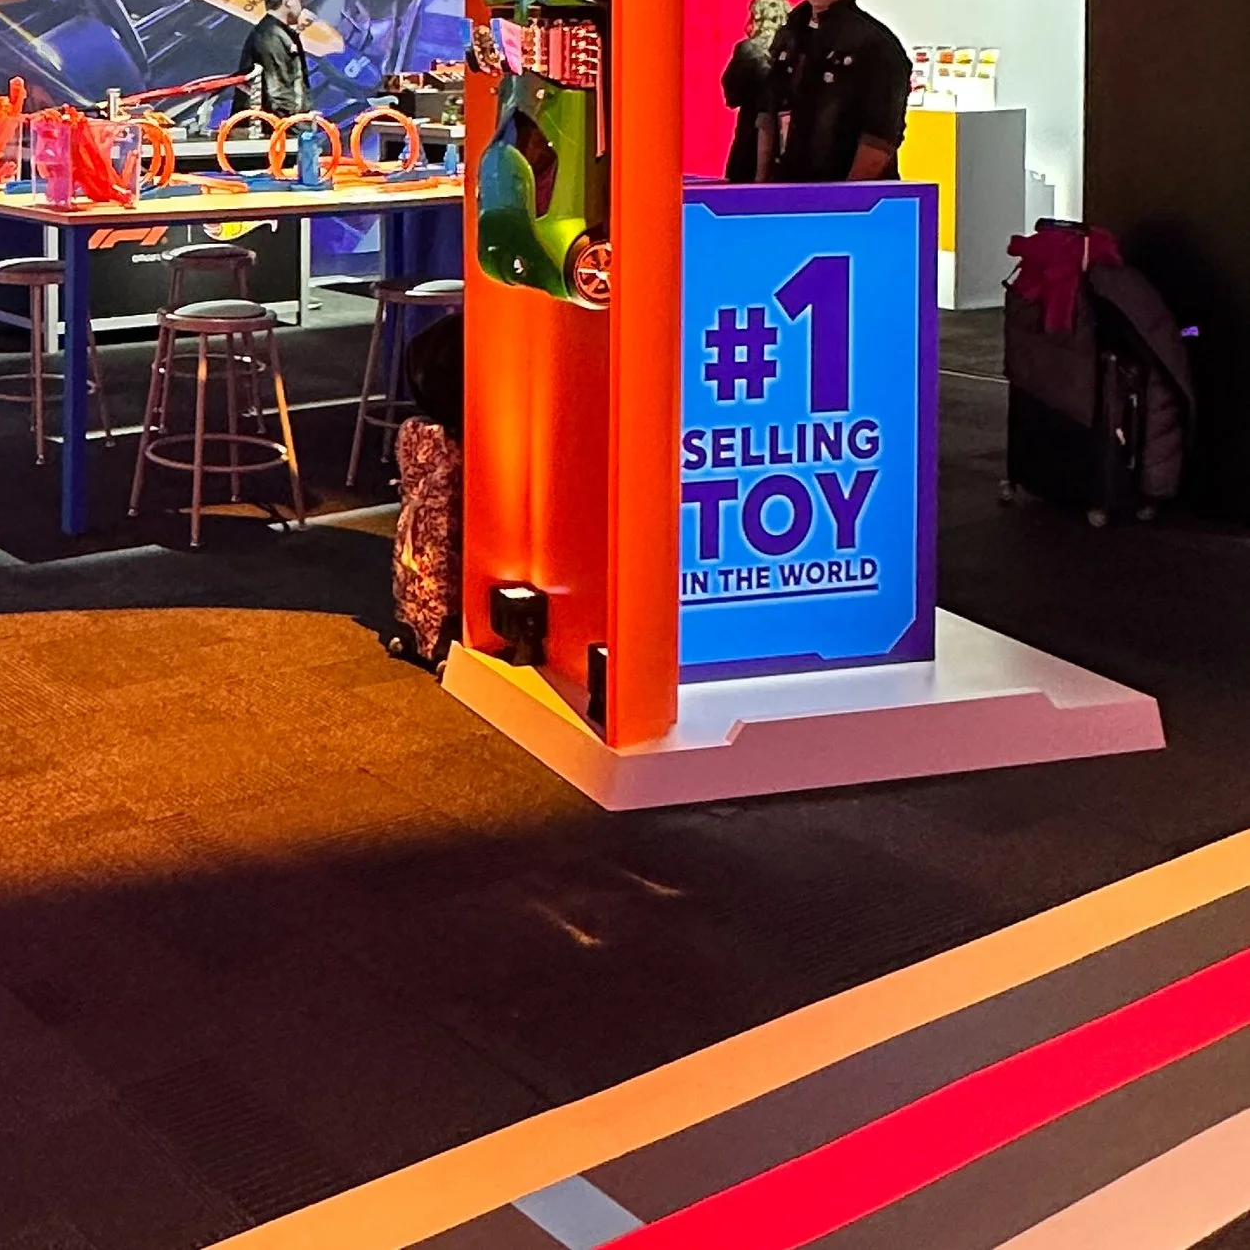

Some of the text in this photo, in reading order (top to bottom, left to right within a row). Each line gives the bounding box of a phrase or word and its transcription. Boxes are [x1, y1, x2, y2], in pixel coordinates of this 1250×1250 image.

[704, 255, 850, 413] #1
[681, 419, 880, 471] SELLING
[681, 469, 880, 561] TOY
[681, 558, 878, 595] IN THE WORLD
